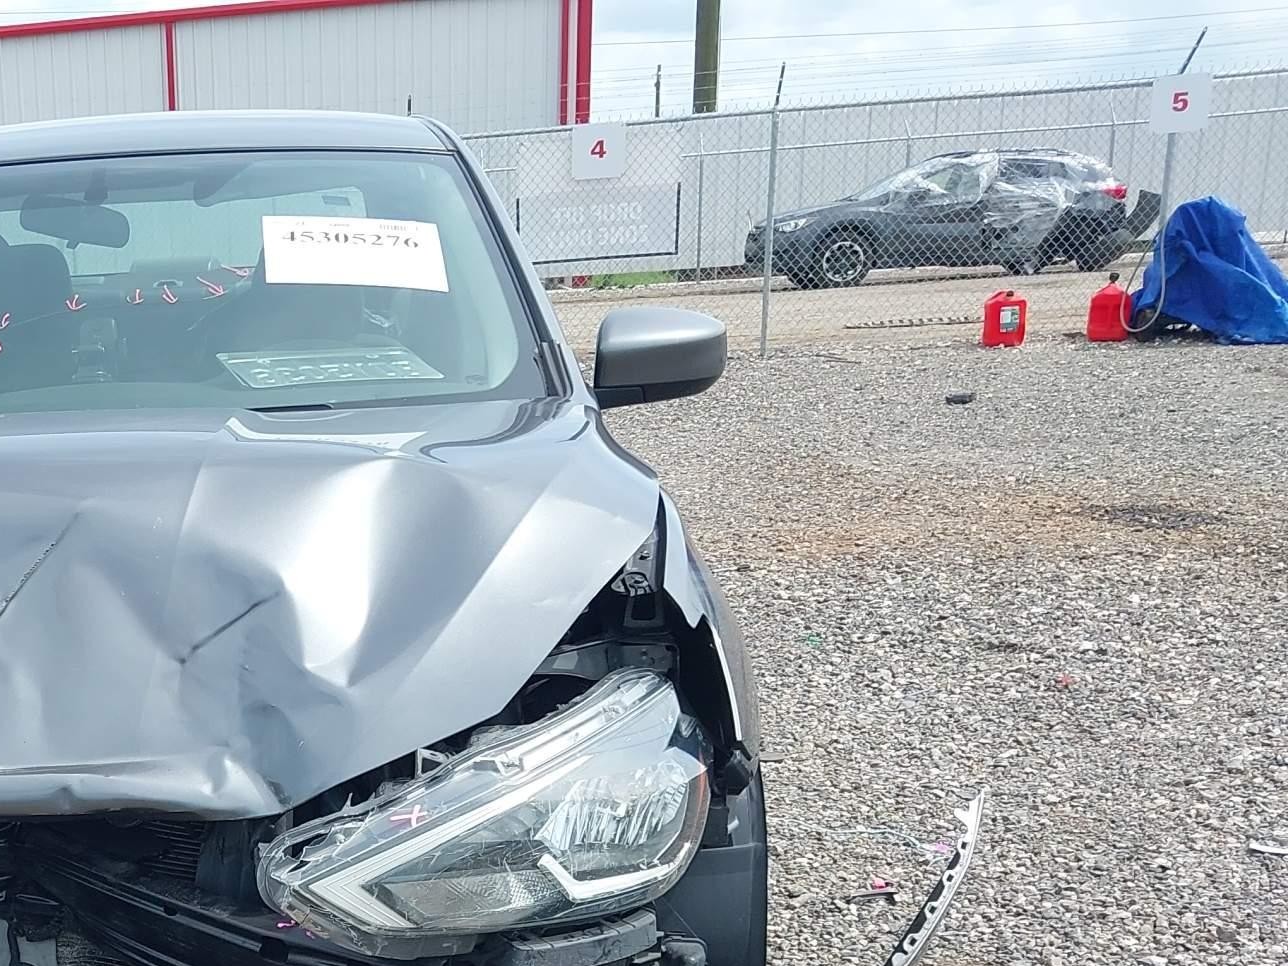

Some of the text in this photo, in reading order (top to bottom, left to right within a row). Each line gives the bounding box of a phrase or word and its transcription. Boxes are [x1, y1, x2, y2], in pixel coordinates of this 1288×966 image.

[1172, 91, 1189, 112] 5
[590, 139, 607, 159] 4
[282, 231, 420, 249] 45305276
